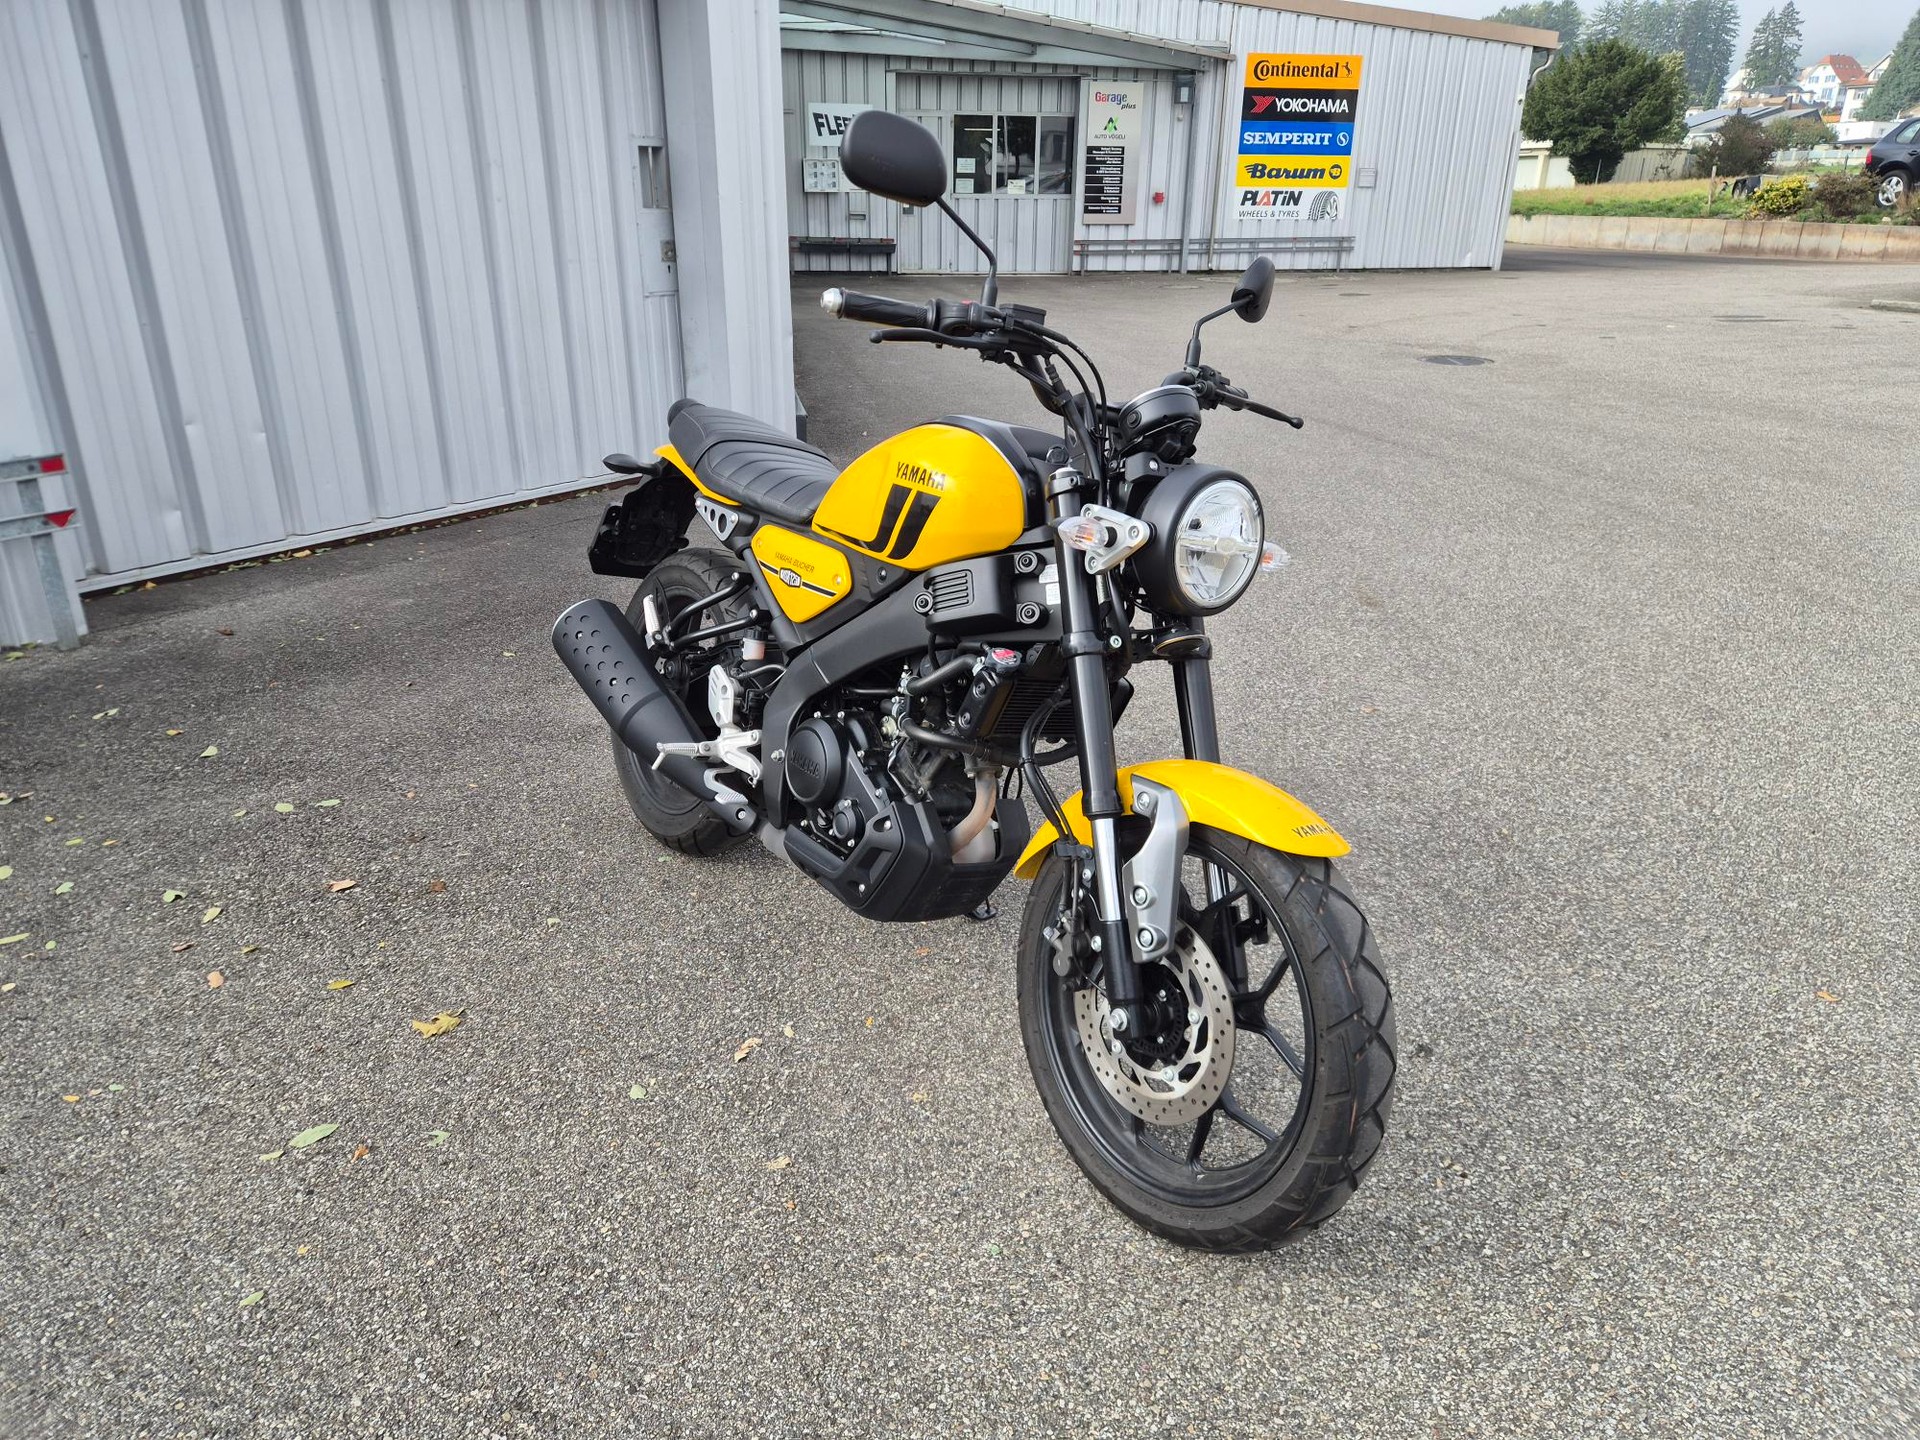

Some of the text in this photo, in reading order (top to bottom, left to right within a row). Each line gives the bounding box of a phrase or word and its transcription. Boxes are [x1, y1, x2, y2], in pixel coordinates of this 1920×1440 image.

[1253, 60, 1339, 81] Continental
[1095, 91, 1128, 105] Garage
[1275, 98, 1349, 113] YOKOHAMA
[812, 112, 855, 137] FLEE
[1243, 132, 1332, 145] SEMPERIT
[1249, 163, 1327, 180] Barum
[1238, 210, 1268, 218] WHEELS
[1278, 210, 1300, 218] TYRES
[896, 461, 946, 491] YAMAHA
